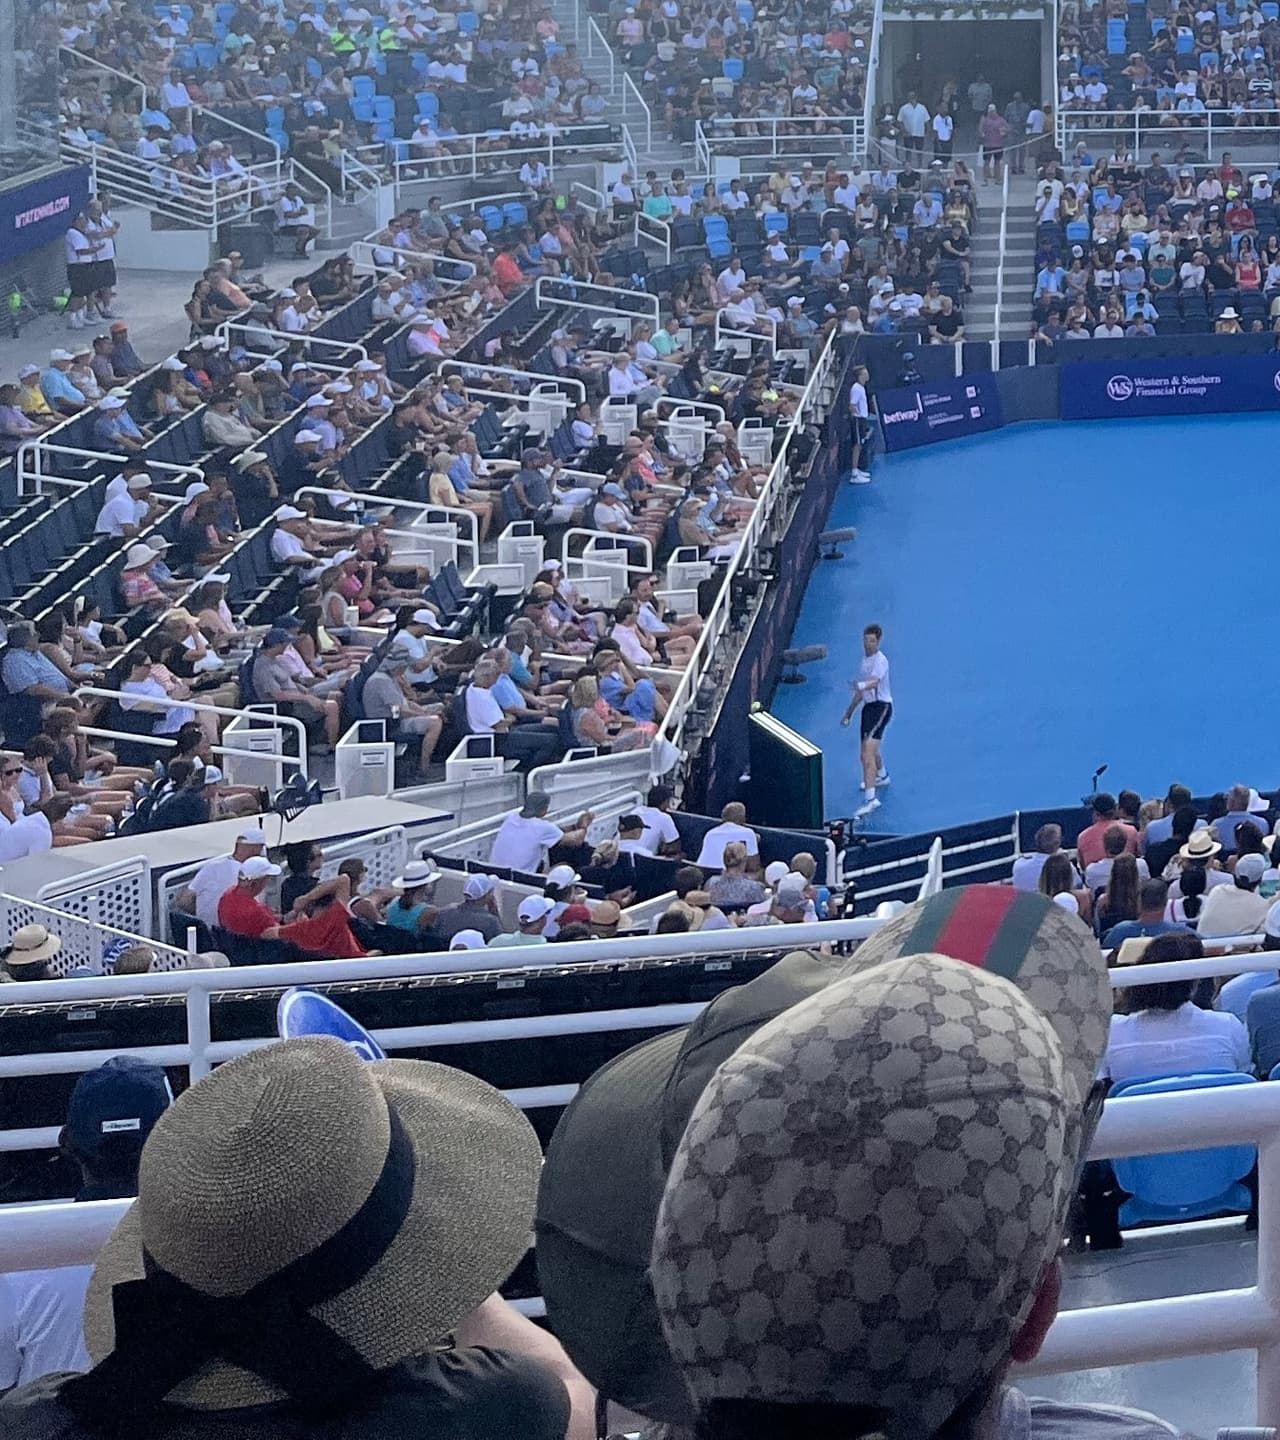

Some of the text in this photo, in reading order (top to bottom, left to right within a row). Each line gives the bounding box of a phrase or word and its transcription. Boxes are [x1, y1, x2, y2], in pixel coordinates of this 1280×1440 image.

[1134, 374, 1221, 386] Western & Southern
[1136, 386, 1206, 396] Financial Group
[883, 409, 919, 425] betway
